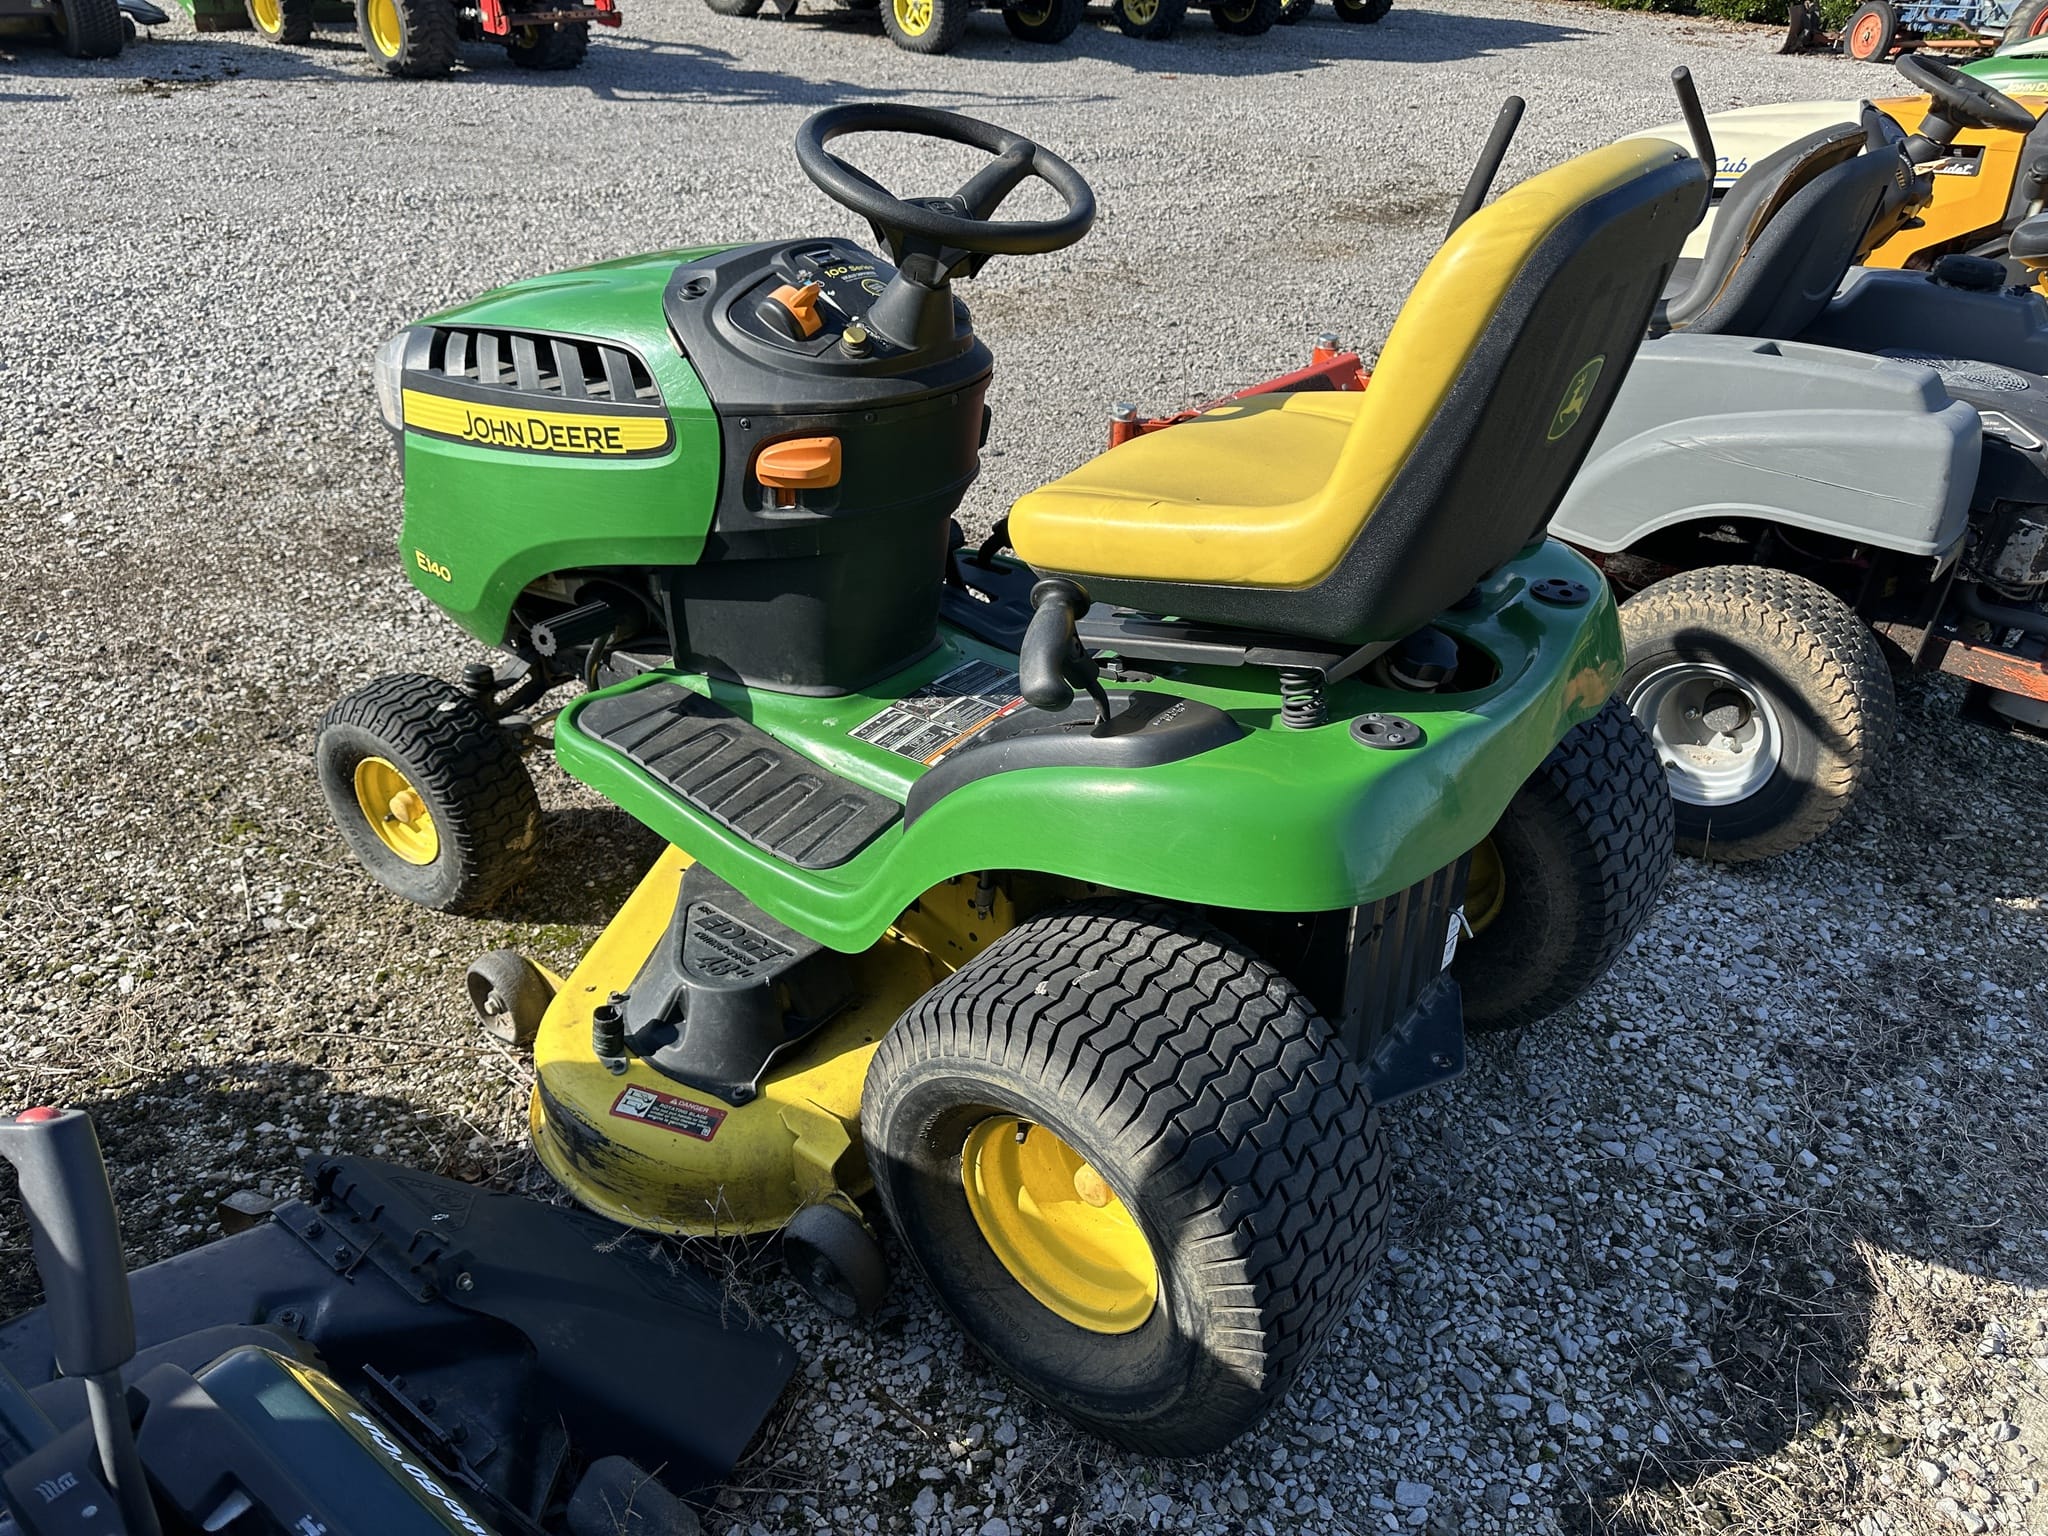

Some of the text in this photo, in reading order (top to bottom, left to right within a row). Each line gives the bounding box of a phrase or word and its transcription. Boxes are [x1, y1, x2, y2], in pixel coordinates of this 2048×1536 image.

[824, 266, 848, 278] 100
[463, 410, 623, 449] JOHN DEERE
[414, 549, 452, 582] E140
[694, 913, 788, 962] EDGE
[659, 1103, 708, 1120] ROTATING BLADE
[677, 1099, 710, 1114] DANGER
